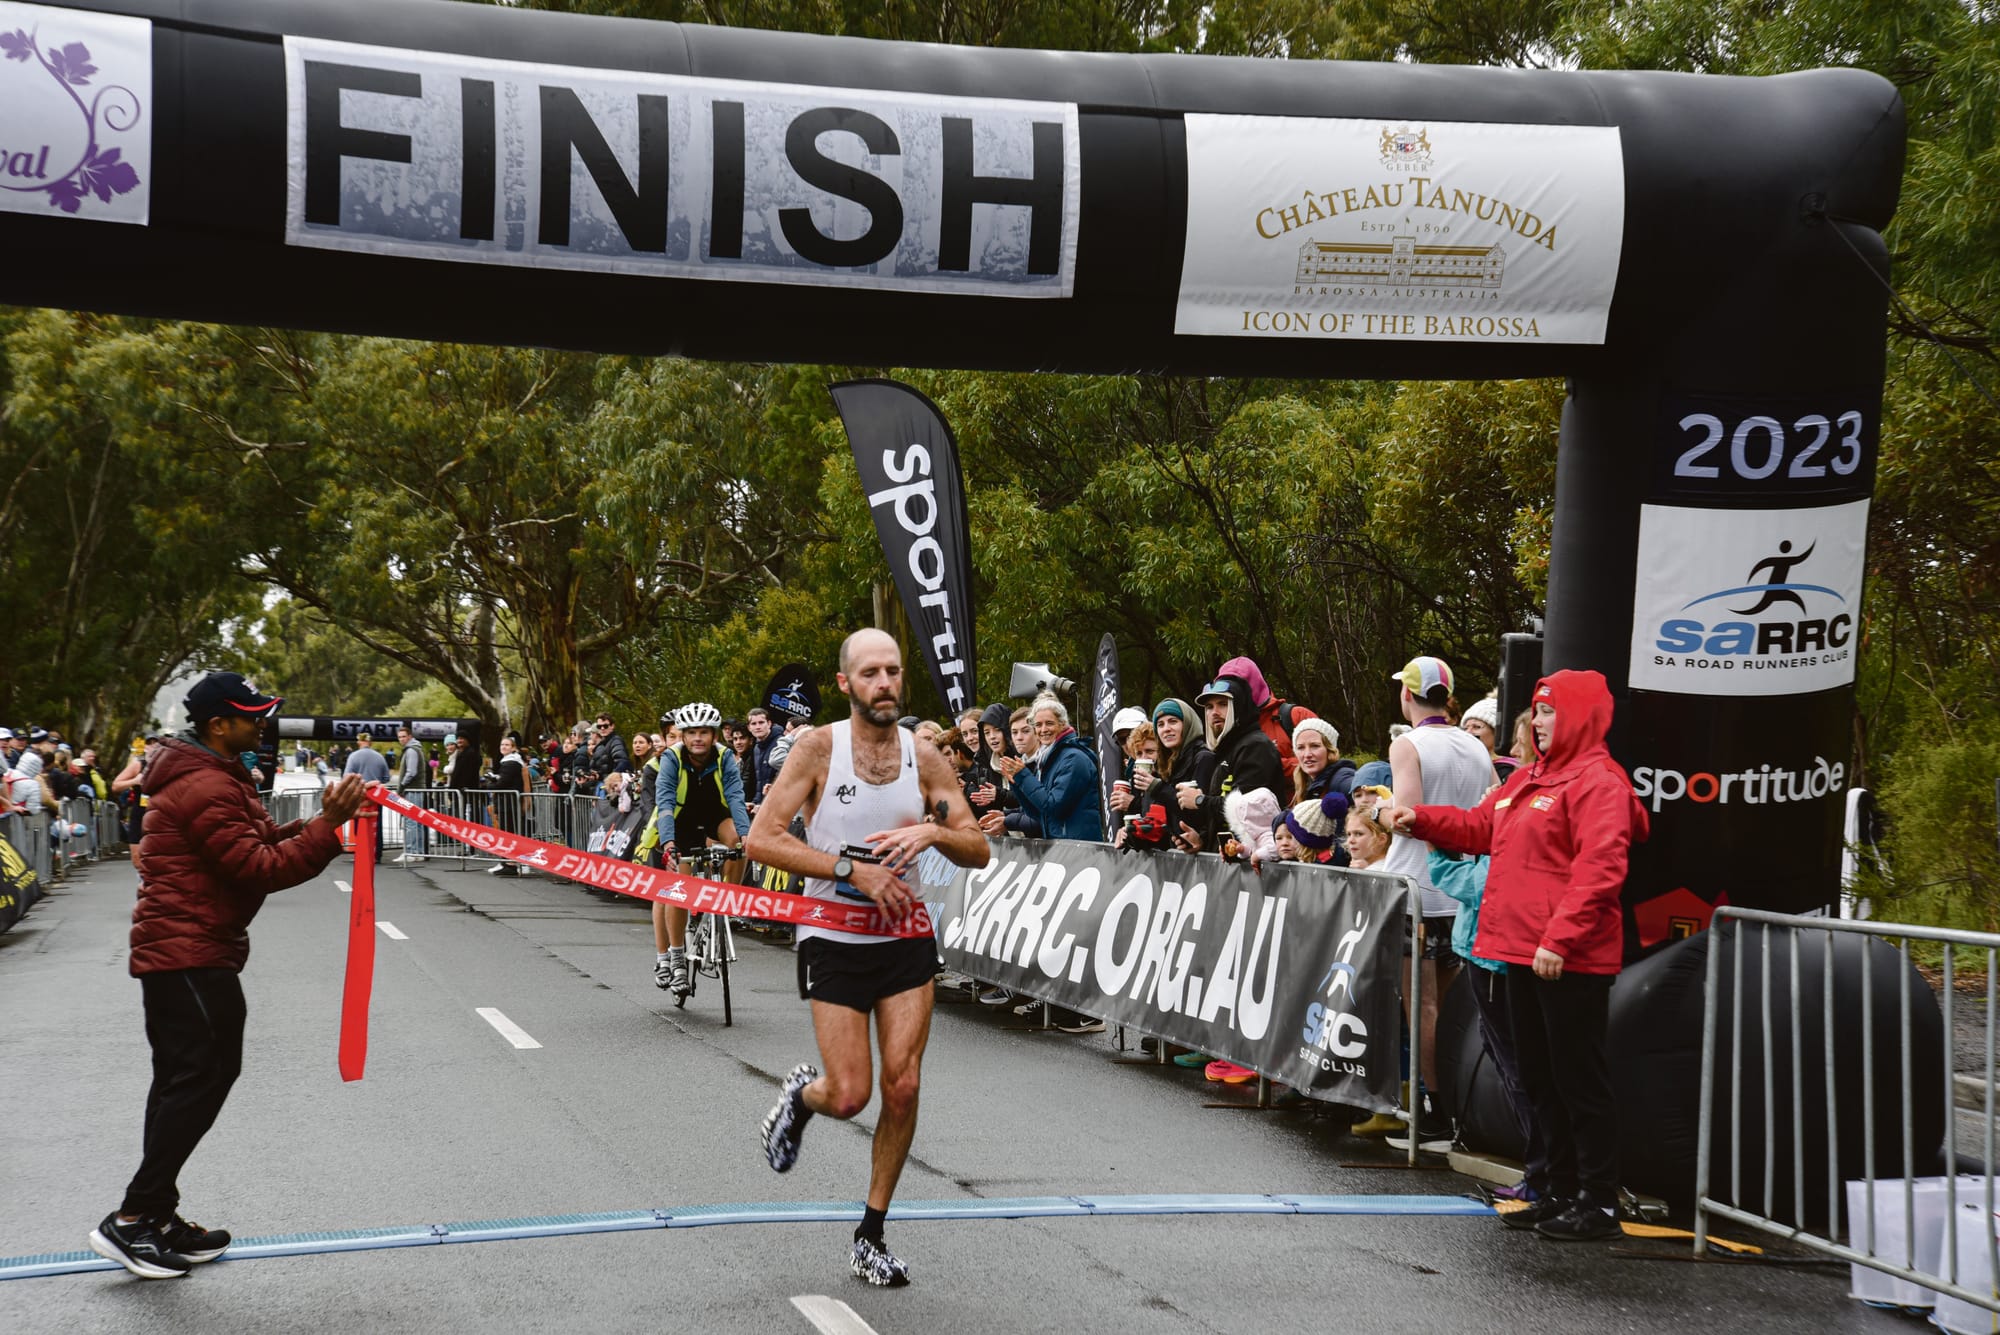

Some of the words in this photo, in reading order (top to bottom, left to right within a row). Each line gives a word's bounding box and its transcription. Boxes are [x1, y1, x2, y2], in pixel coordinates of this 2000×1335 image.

[304, 60, 1064, 275] FINISH
[1386, 163, 1428, 172] GEBER
[1256, 184, 1404, 240] CHÂTEAU
[1409, 177, 1557, 251] TANUNDA
[1416, 223, 1450, 234] 1890
[1294, 286, 1378, 297] BAROSSA
[1392, 288, 1499, 300] AUSTRALIA
[1242, 311, 1312, 332] ICON
[1319, 313, 1355, 333] OF
[1362, 314, 1416, 335] THE
[1424, 315, 1541, 337] BAROSSA
[1674, 410, 1863, 480] 2023
[1654, 655, 1676, 666] SA
[1685, 658, 1734, 670] ROAD
[1743, 657, 1817, 670] RUNNERS
[1823, 650, 1849, 664] CLUB
[335, 722, 401, 737] START
[1633, 756, 1844, 812] sportitude
[554, 854, 657, 895] FINISH
[693, 885, 795, 918] FINISH
[1321, 1058, 1367, 1077] CLUB
